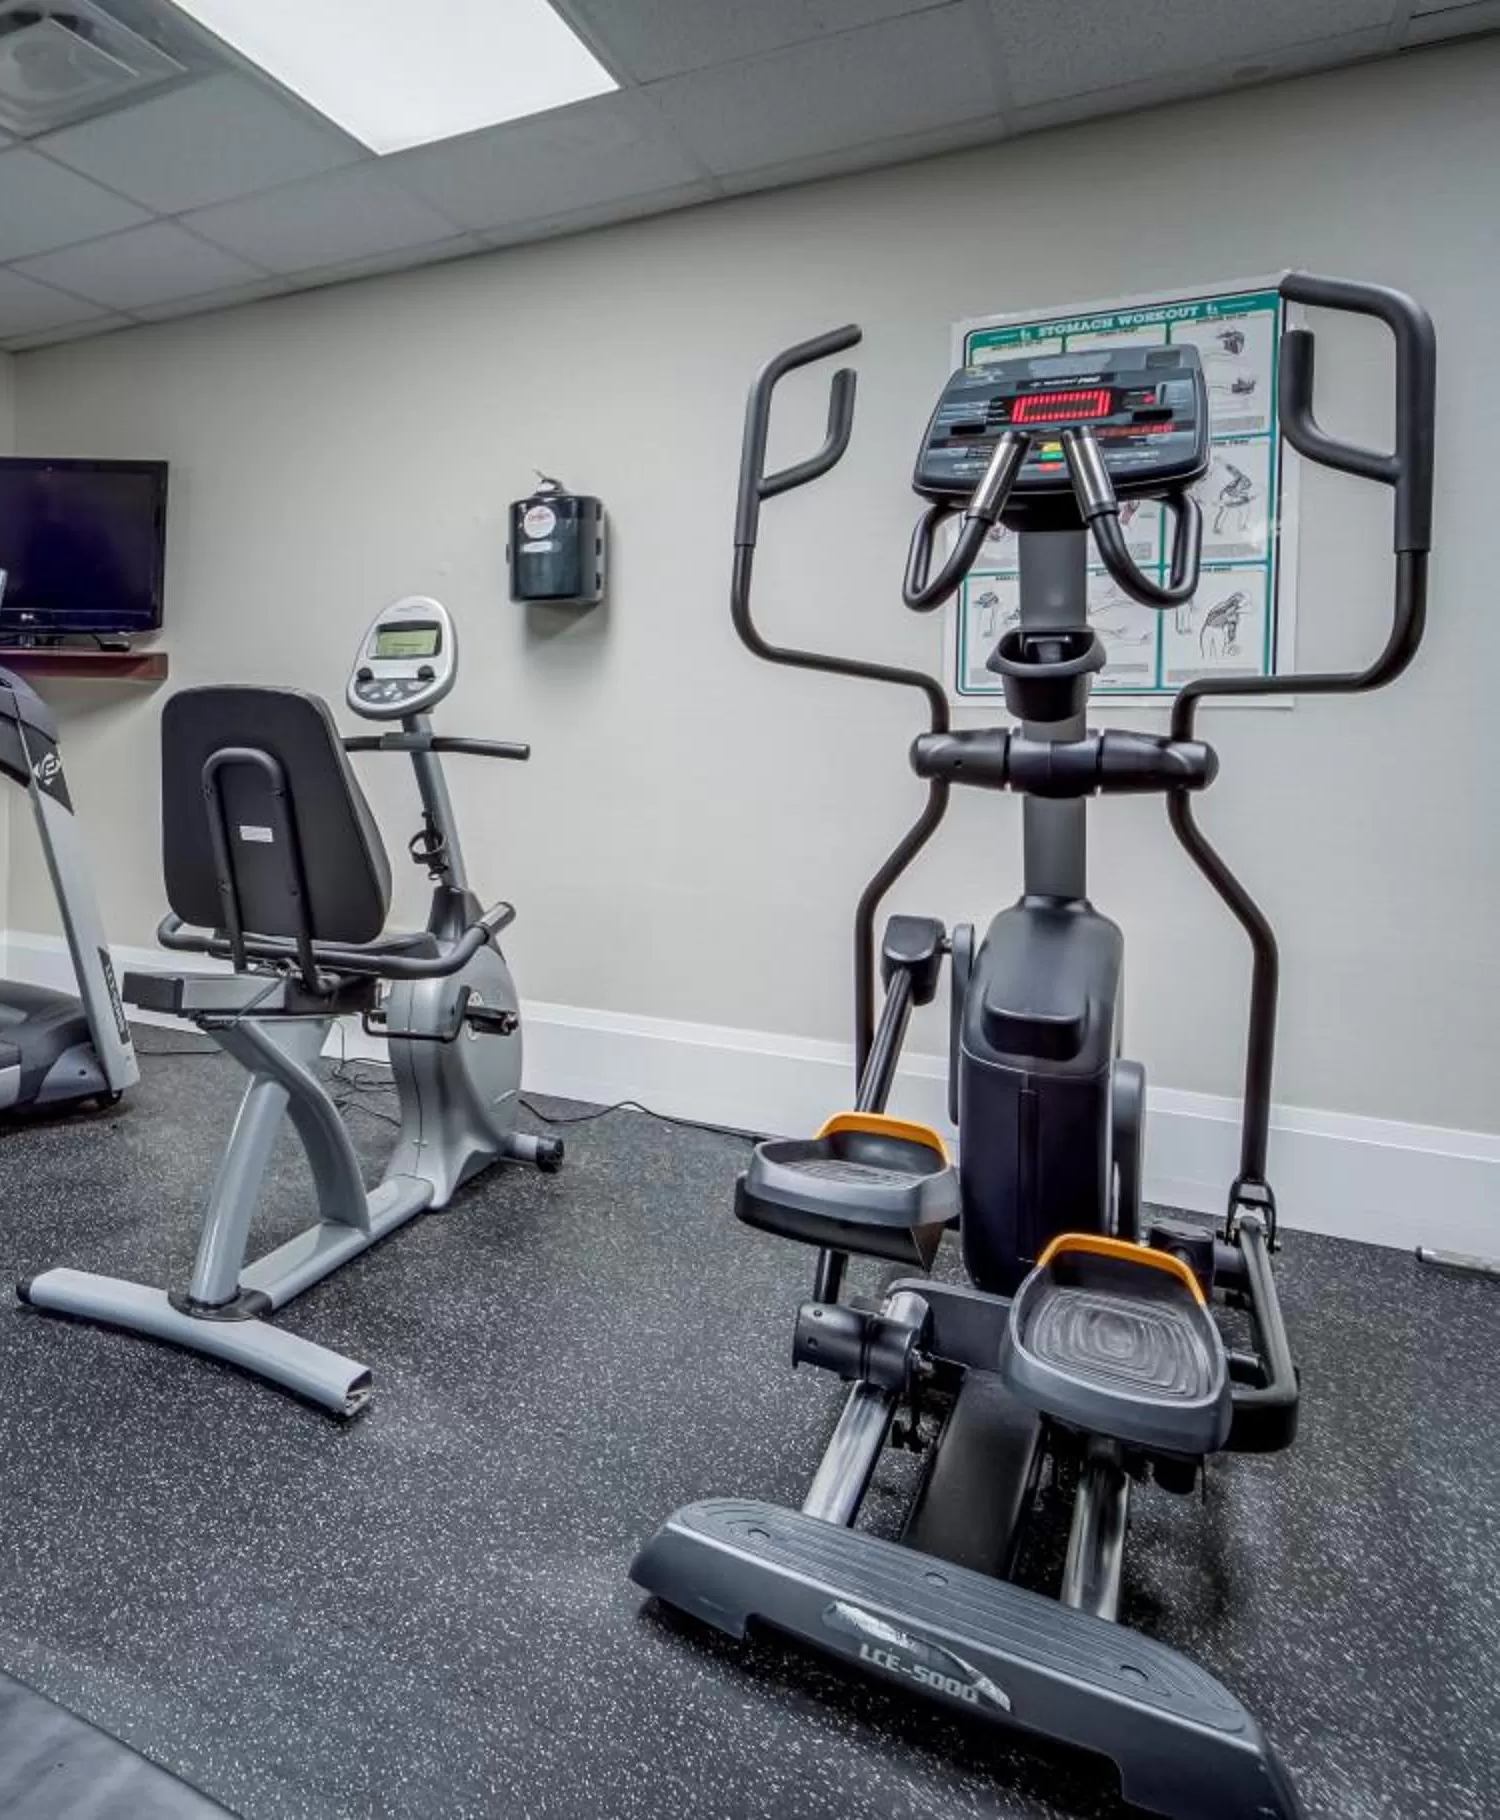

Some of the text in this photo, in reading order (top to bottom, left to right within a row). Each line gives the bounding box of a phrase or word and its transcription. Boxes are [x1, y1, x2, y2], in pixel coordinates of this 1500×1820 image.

[1039, 318, 1113, 336] STOMACH
[1118, 306, 1198, 326] WORKOUT
[860, 1643, 979, 1704] LCE-5000
